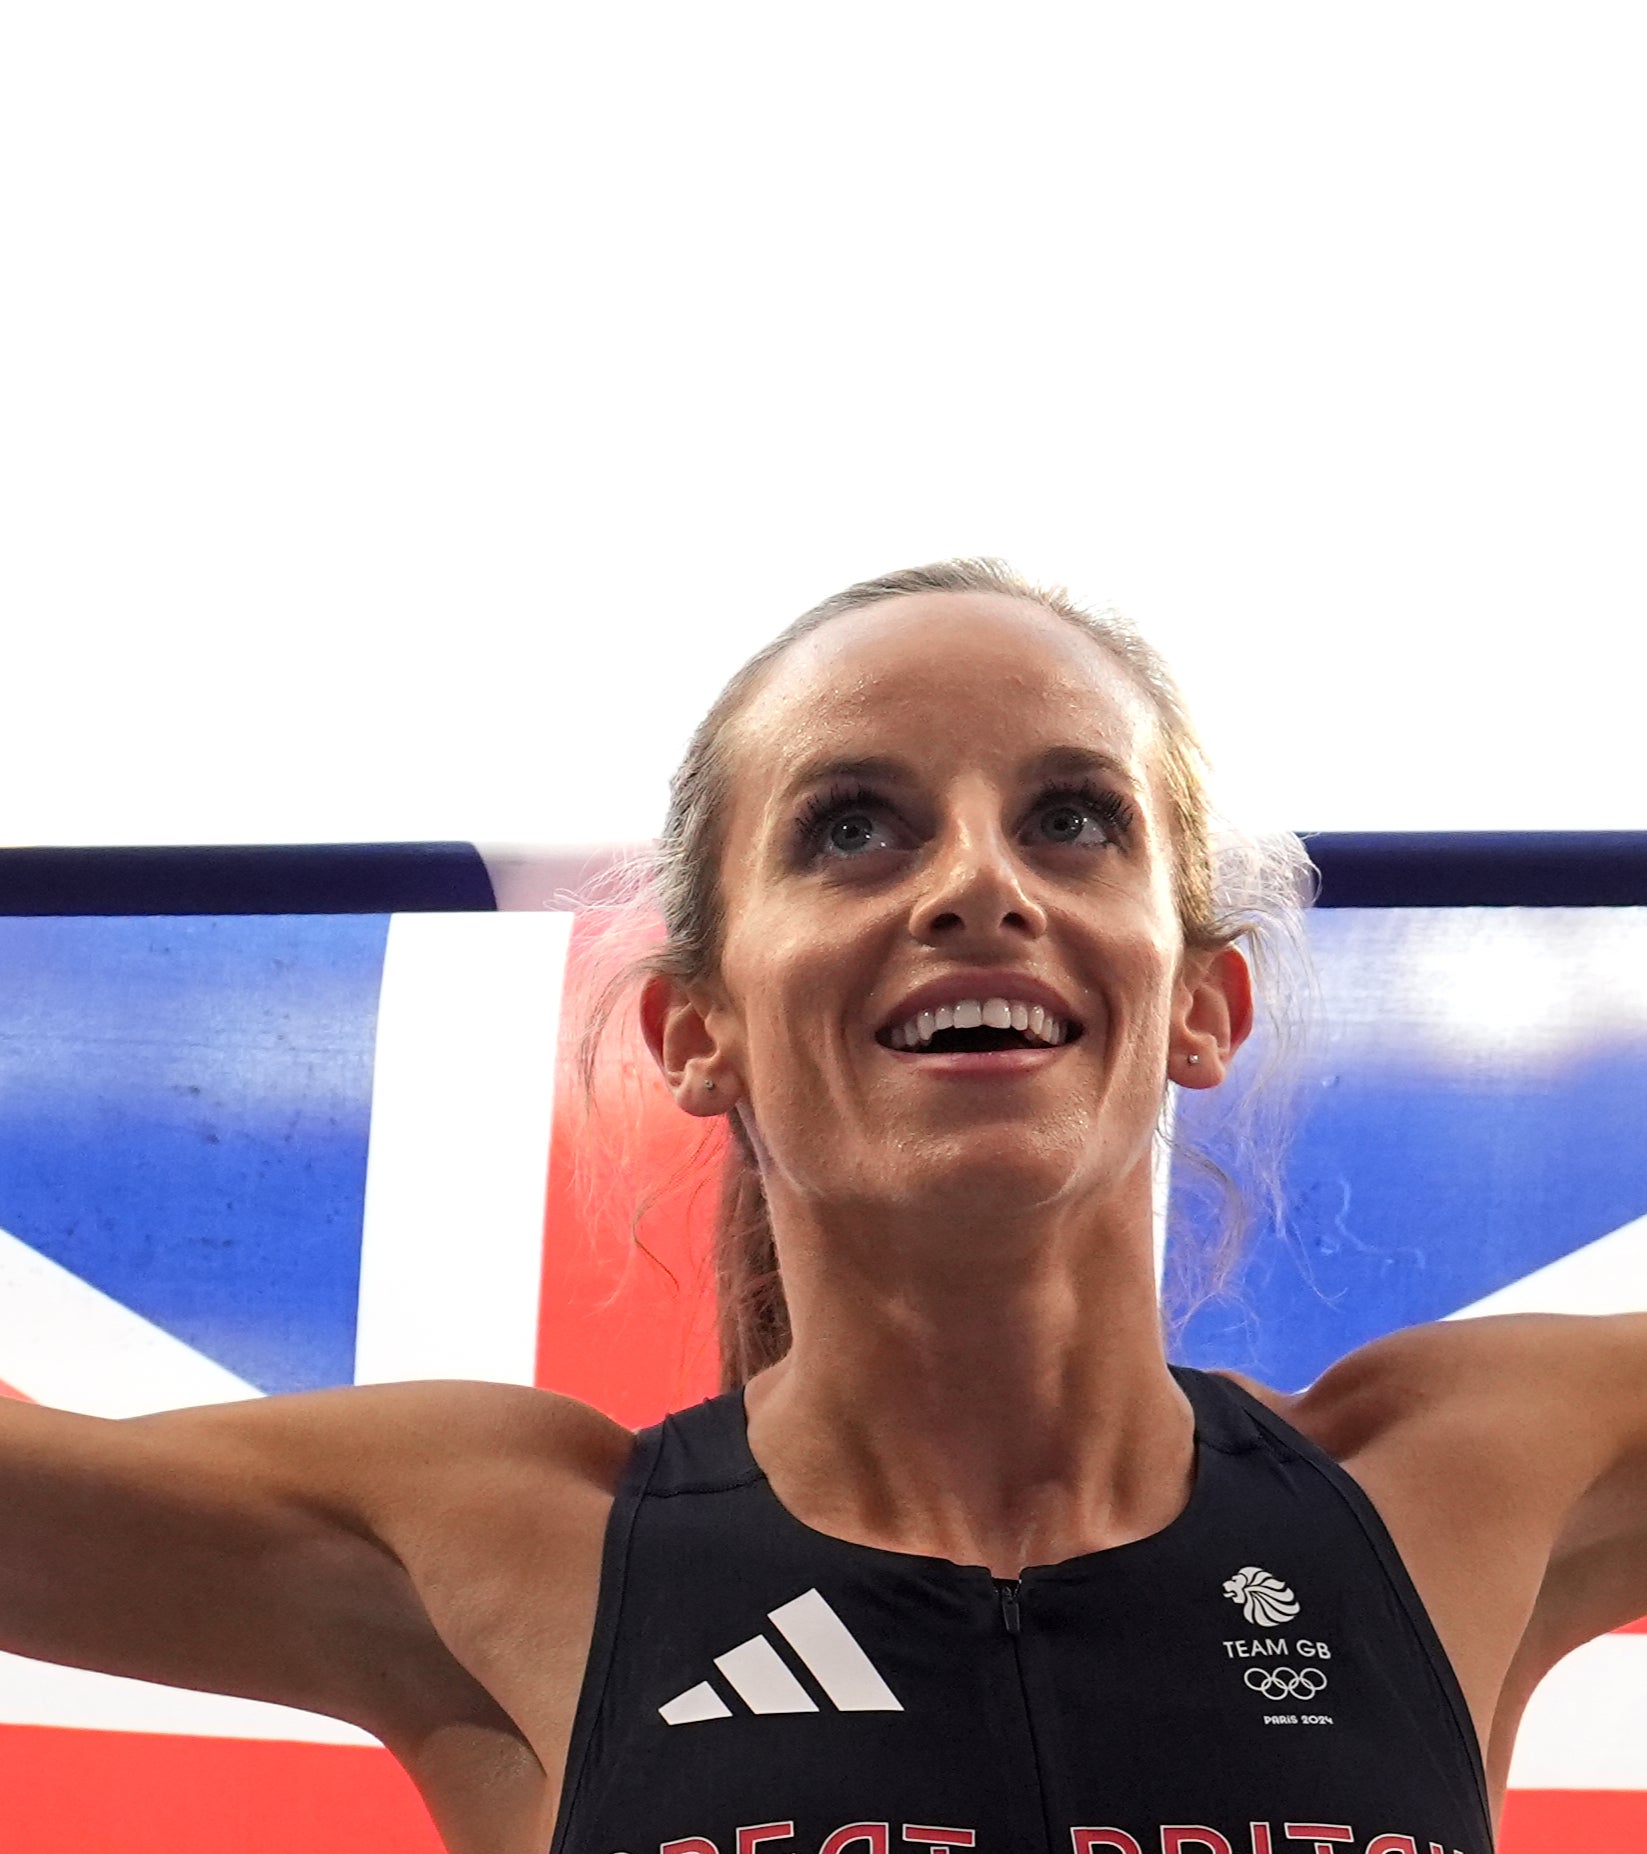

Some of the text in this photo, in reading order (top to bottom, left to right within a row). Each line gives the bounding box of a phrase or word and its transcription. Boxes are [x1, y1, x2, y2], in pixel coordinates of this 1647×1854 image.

[1223, 1638, 1331, 1659] TEAM GB
[1301, 1715, 1333, 1725] 2024
